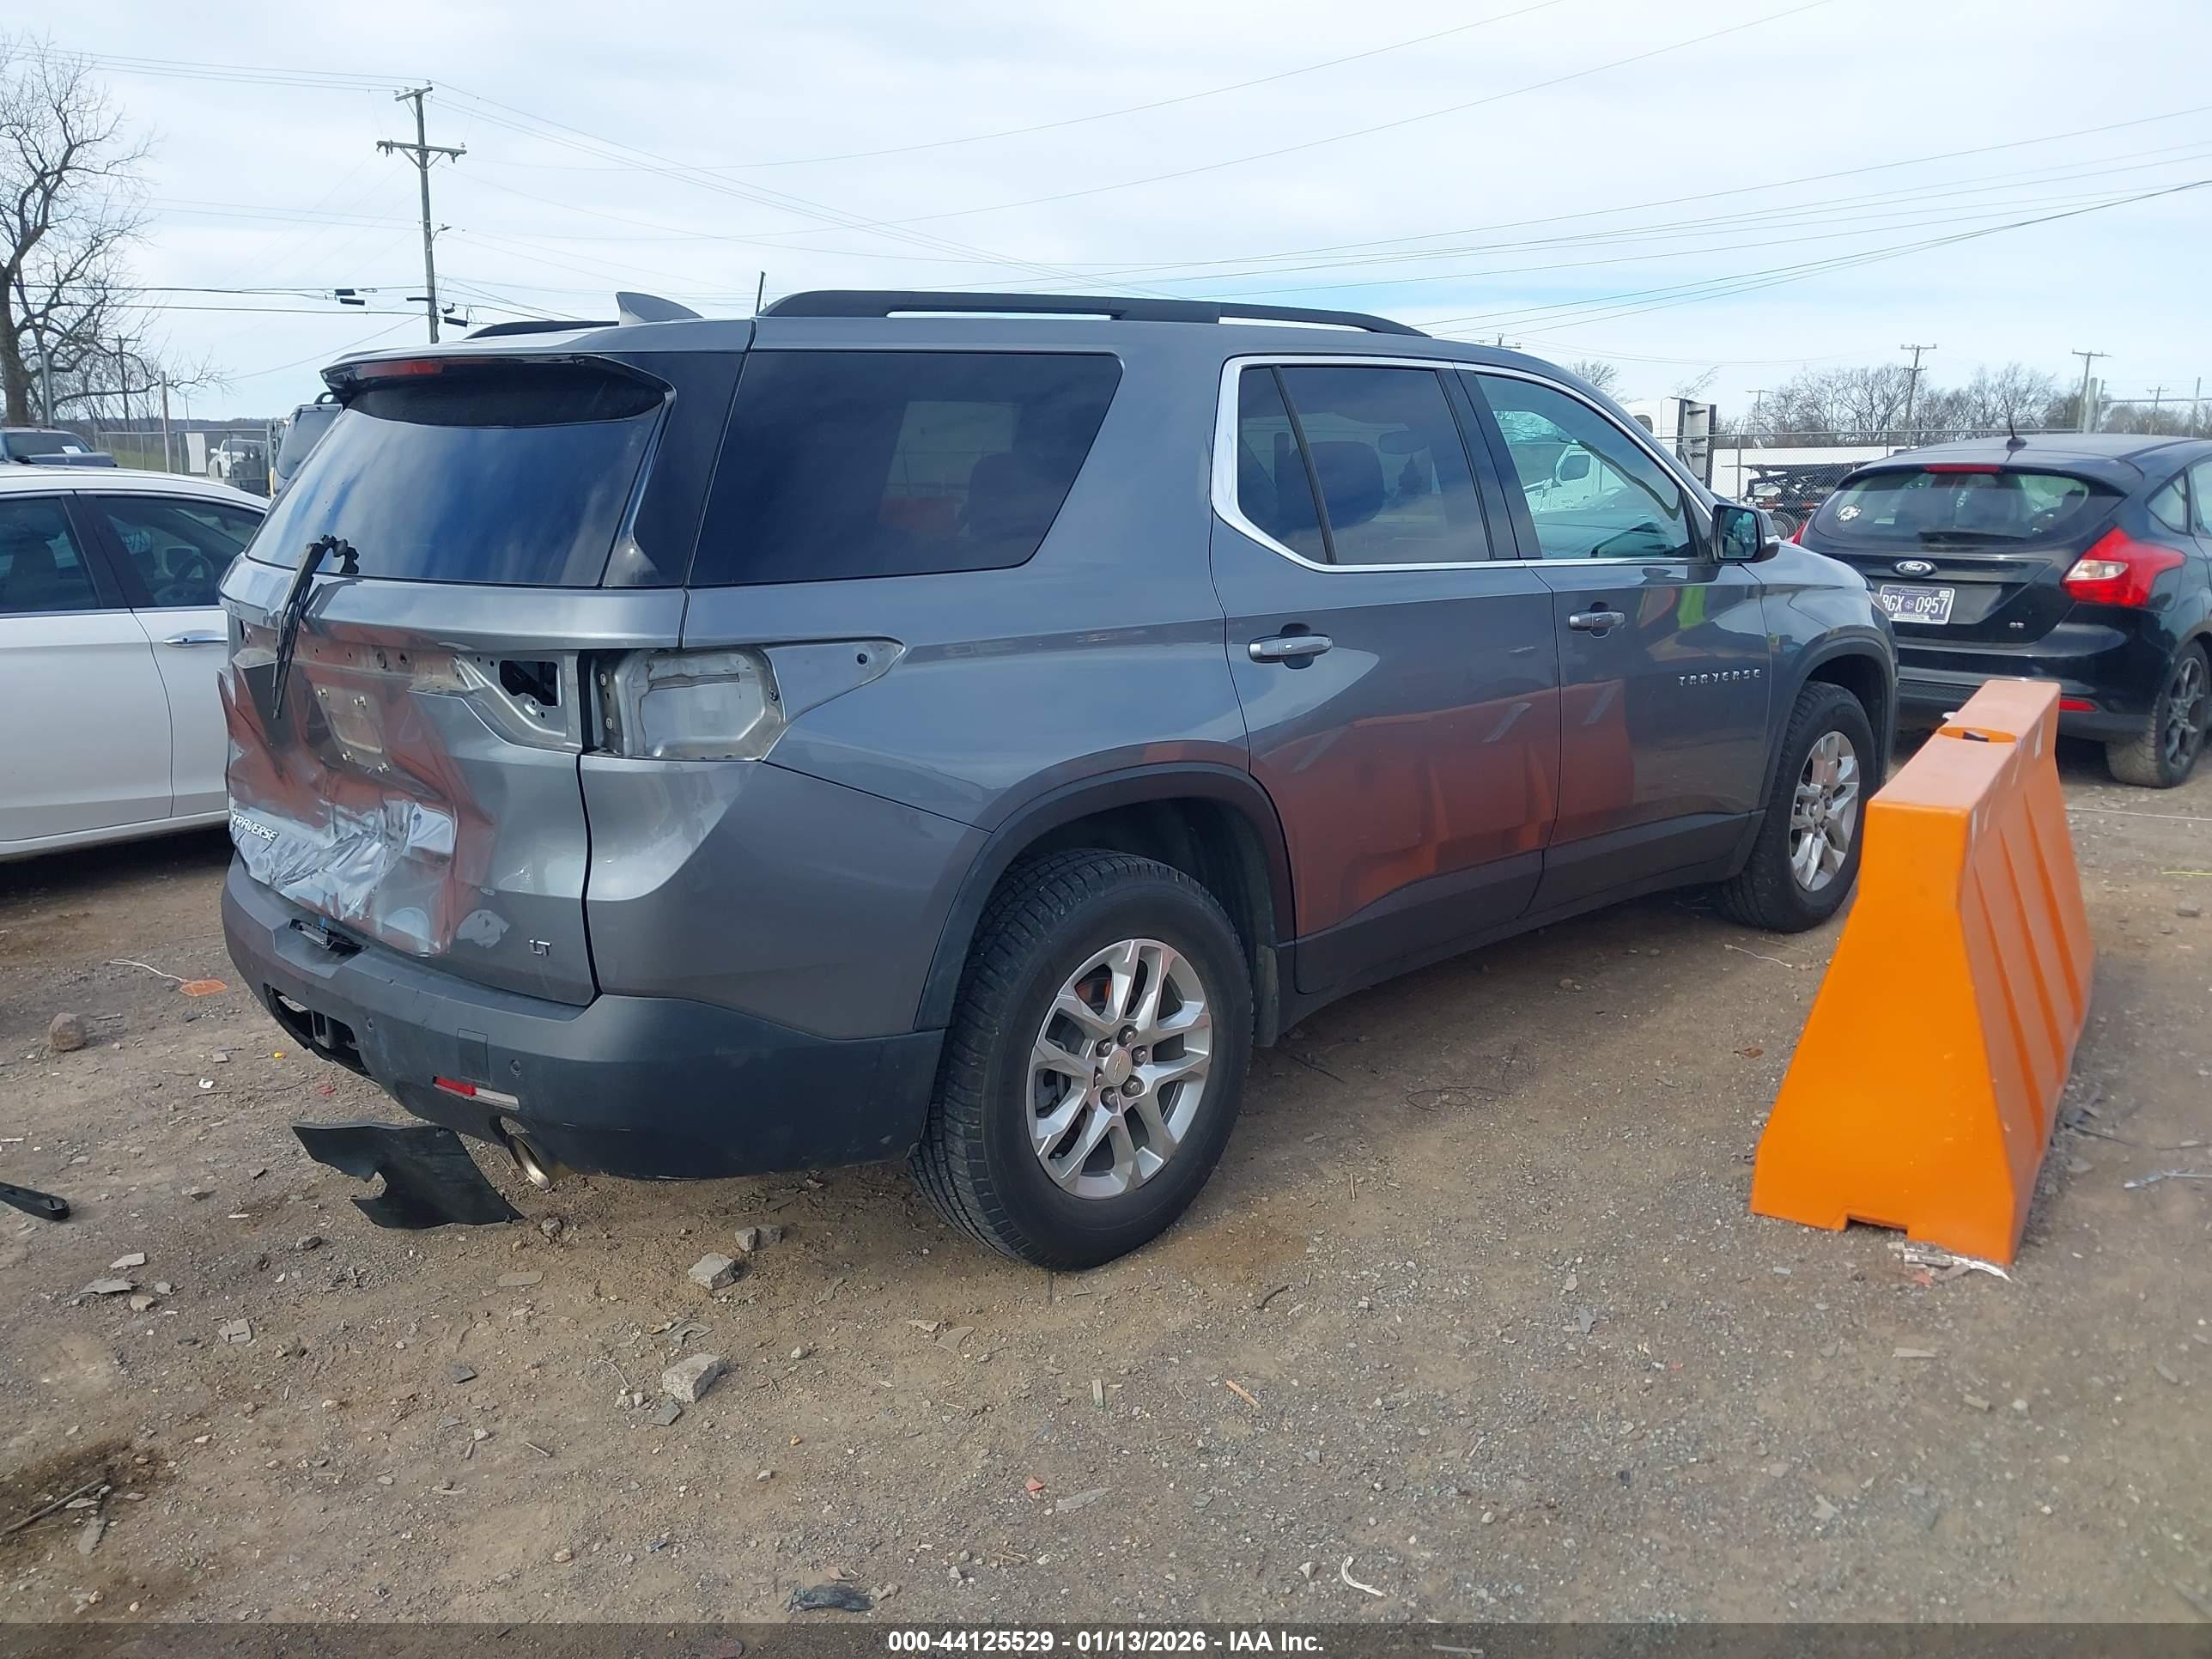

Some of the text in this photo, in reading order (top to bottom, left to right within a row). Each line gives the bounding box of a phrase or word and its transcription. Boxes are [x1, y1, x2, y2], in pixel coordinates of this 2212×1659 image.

[1915, 596, 1948, 615] 0957
[1678, 668, 1761, 687] TRAVERSE
[233, 813, 279, 842] TRAVERSE
[528, 939, 550, 956] LT
